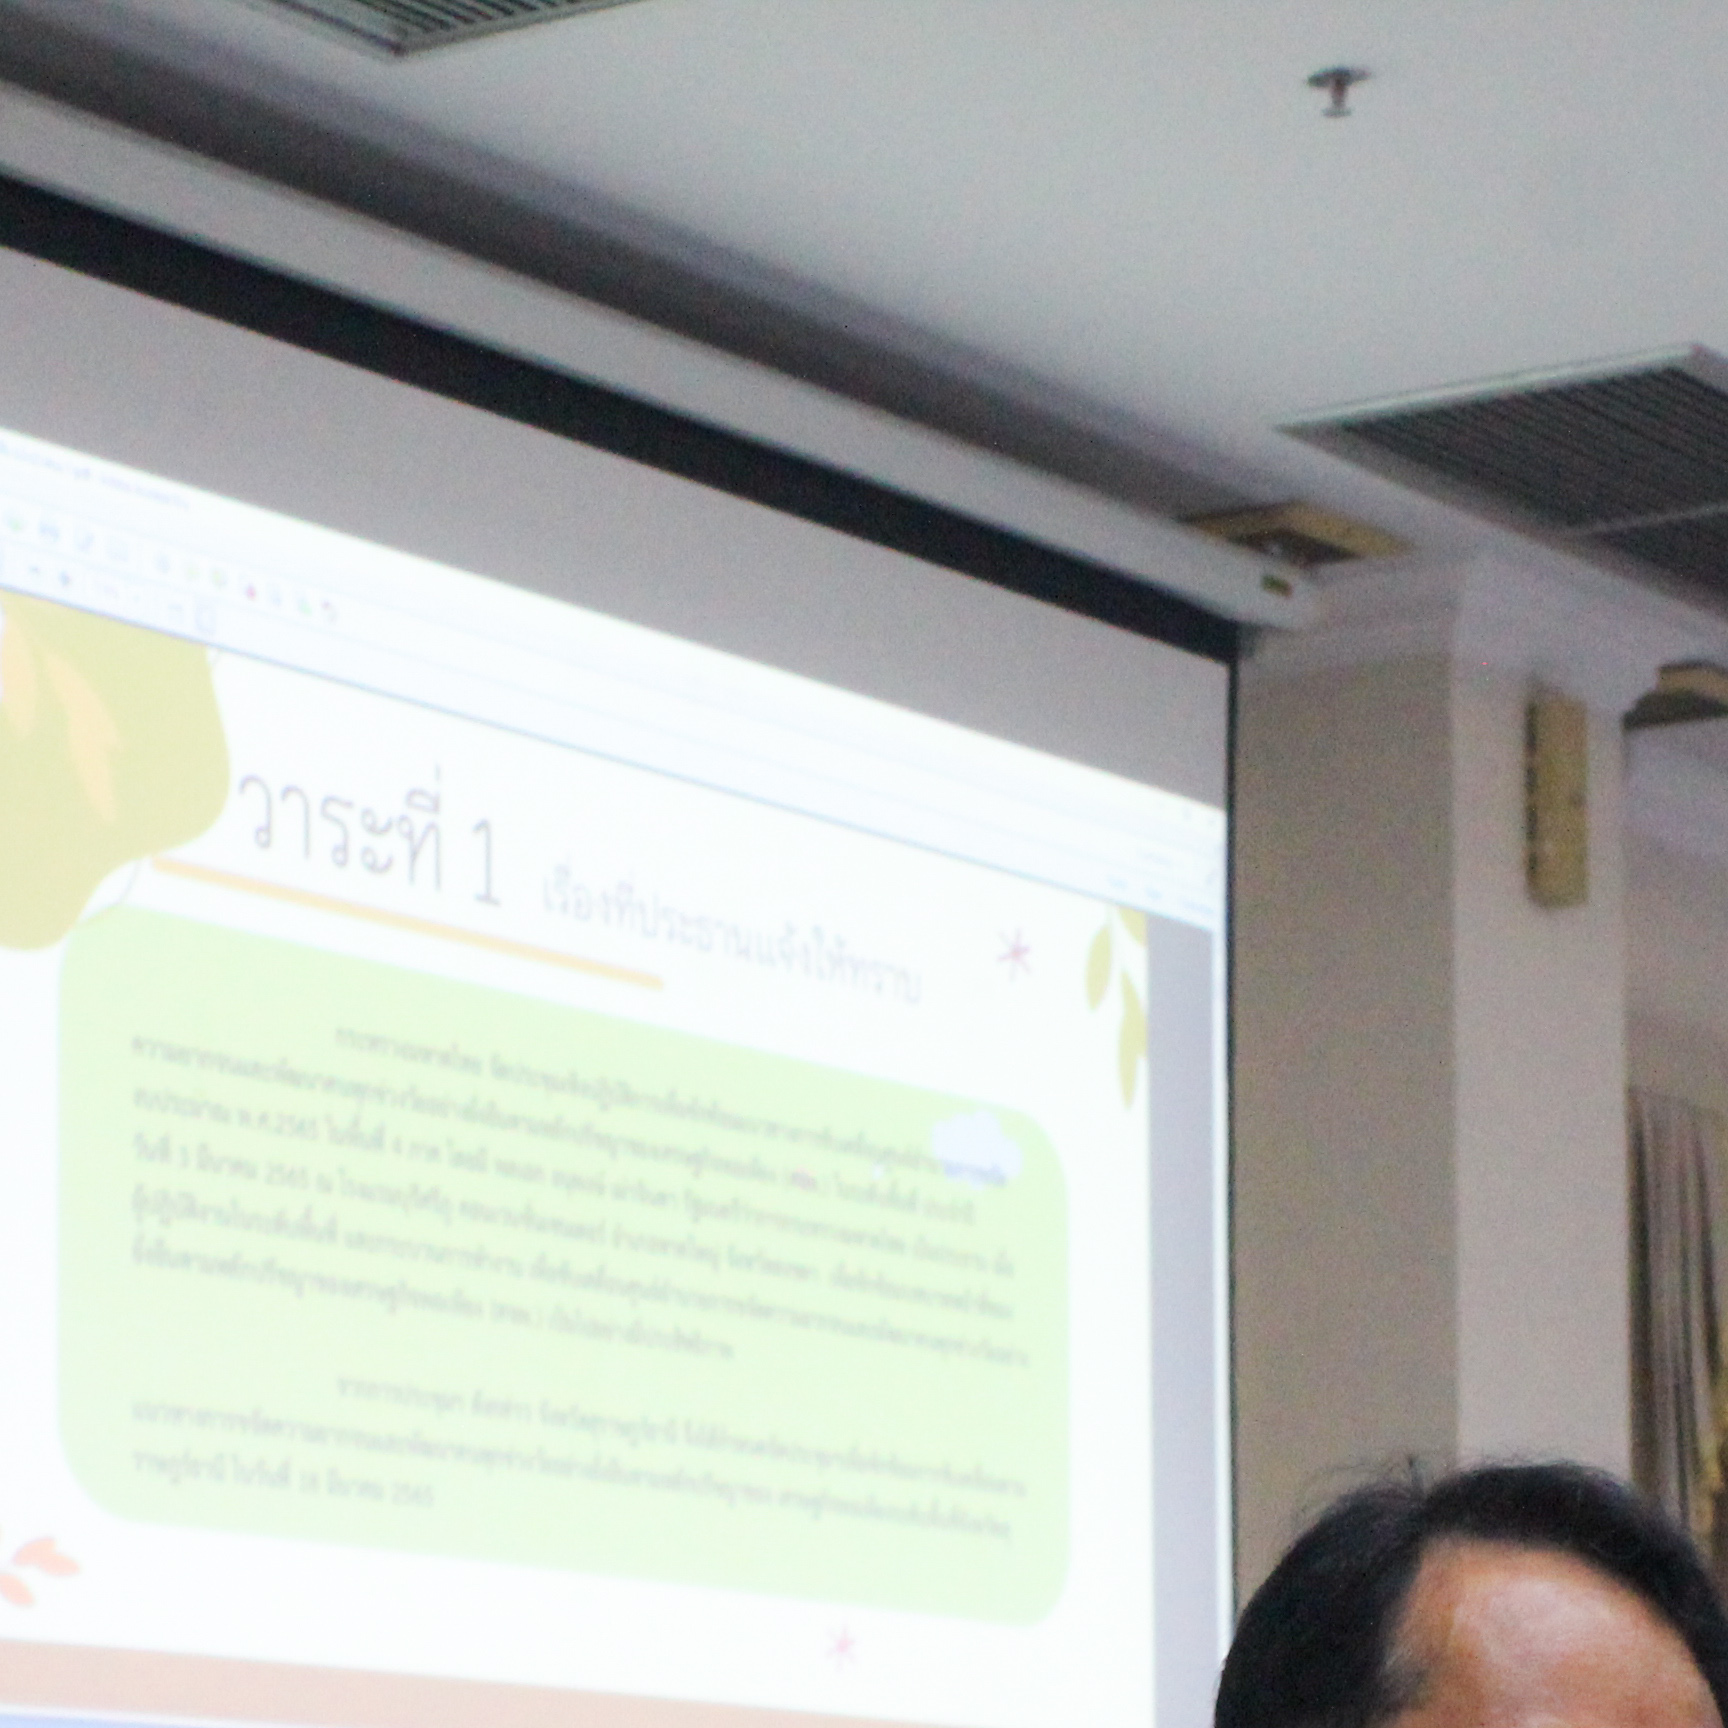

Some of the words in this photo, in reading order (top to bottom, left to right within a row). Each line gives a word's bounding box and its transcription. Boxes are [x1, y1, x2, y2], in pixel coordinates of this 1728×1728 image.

[239, 764, 445, 892] วาระที่
[471, 818, 502, 908] 1
